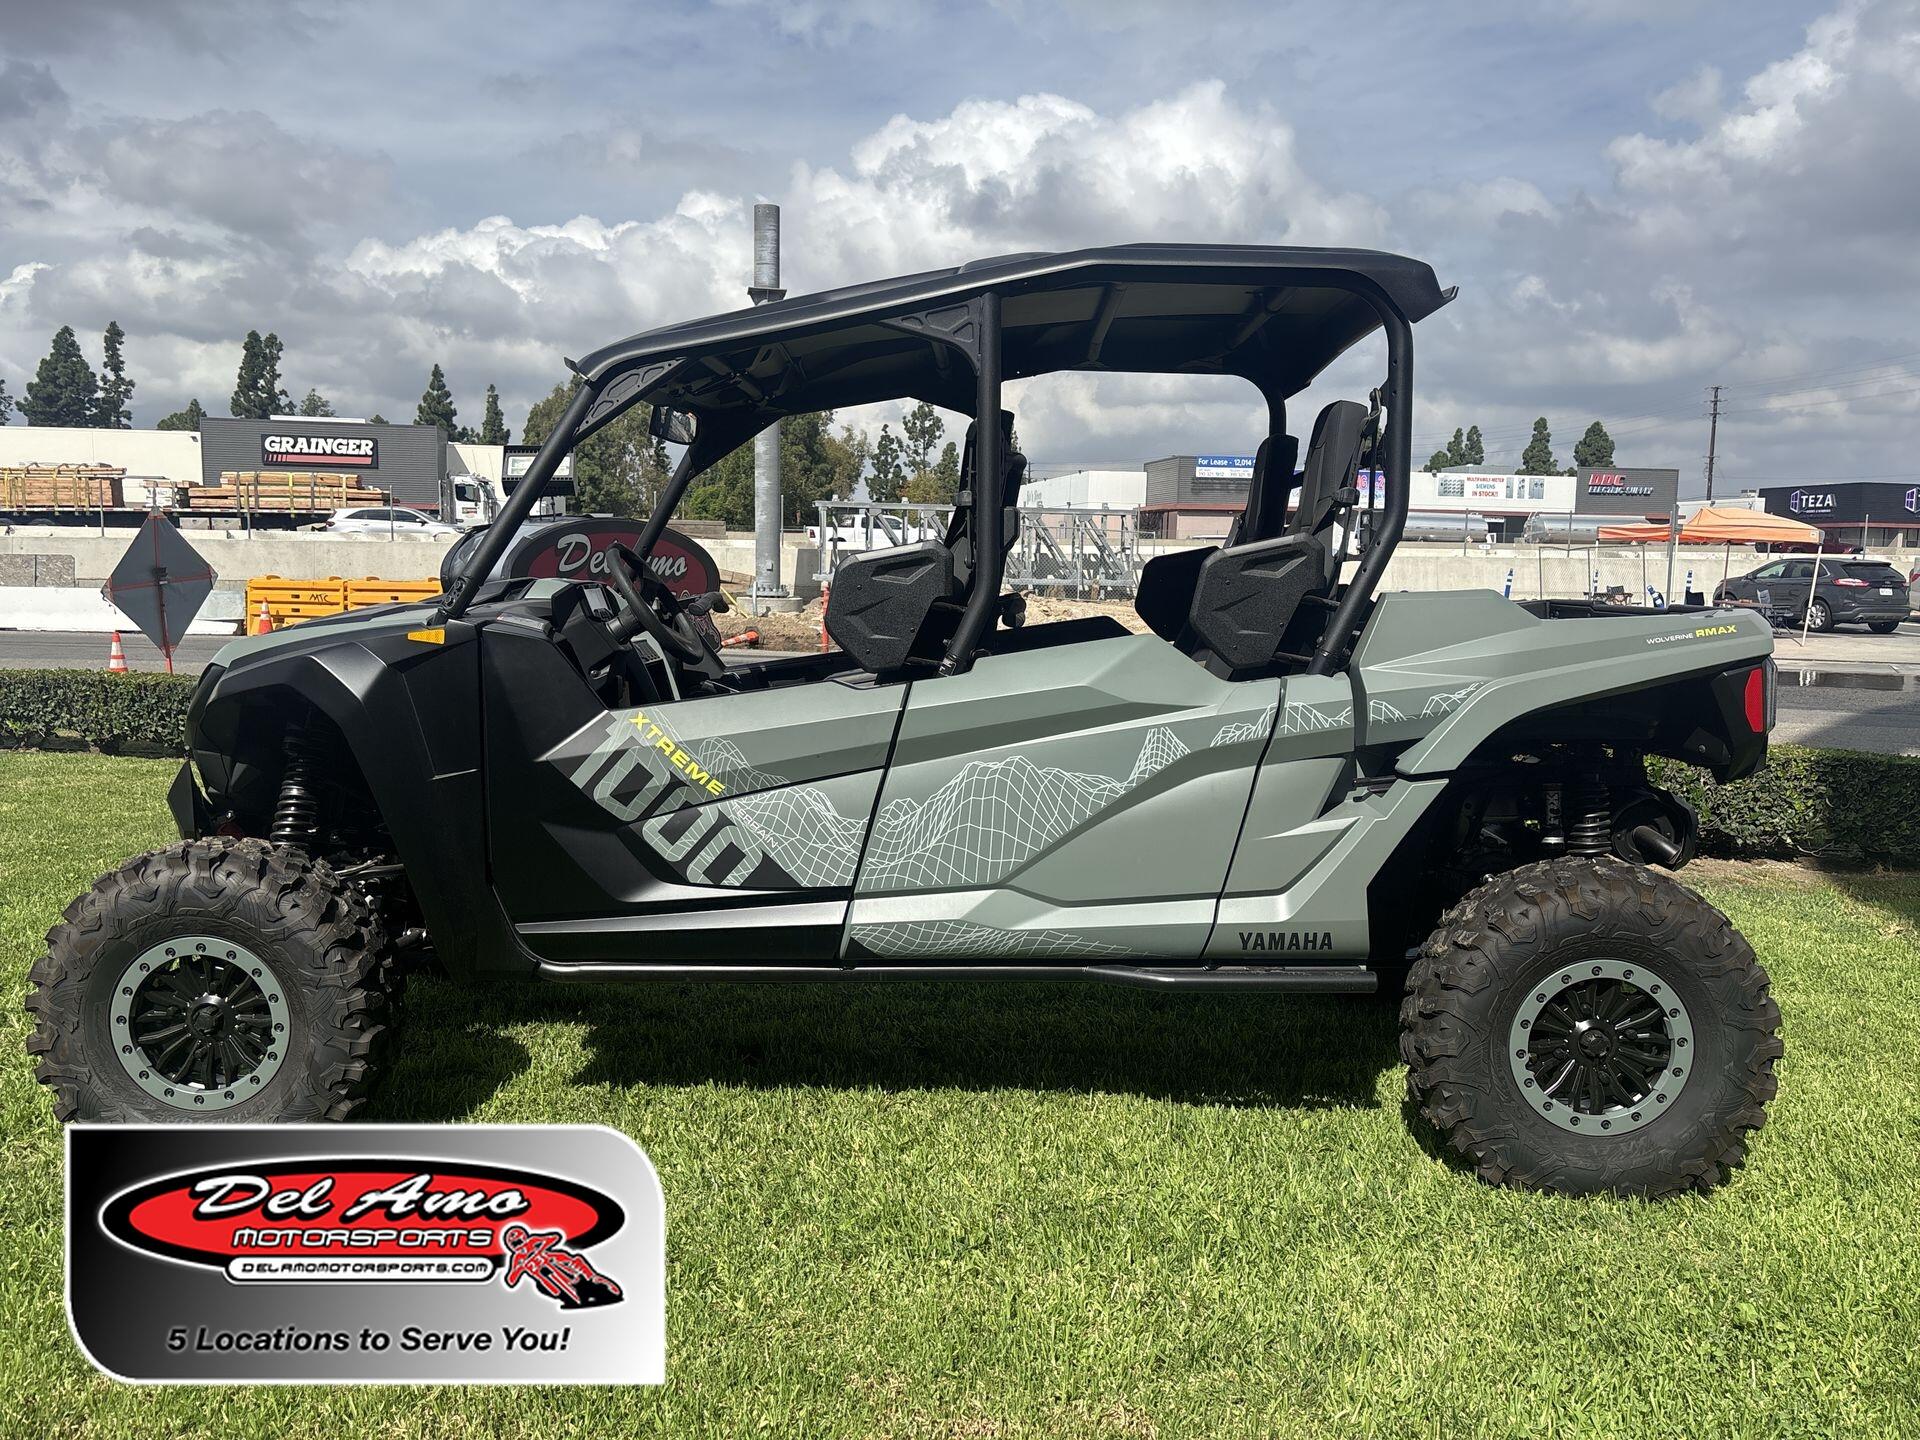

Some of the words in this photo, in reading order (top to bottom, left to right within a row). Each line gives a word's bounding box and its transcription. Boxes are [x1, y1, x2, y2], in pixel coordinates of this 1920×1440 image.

[264, 436, 373, 455] GRAINGER
[1210, 458, 1228, 466] Lease
[1801, 495, 1833, 507] TEZA
[1646, 633, 1693, 645] WOLVERINE
[1695, 625, 1738, 637] RMAX
[629, 712, 726, 795] XTREME
[570, 717, 763, 886] 1000
[1239, 932, 1333, 951] YAMAHA
